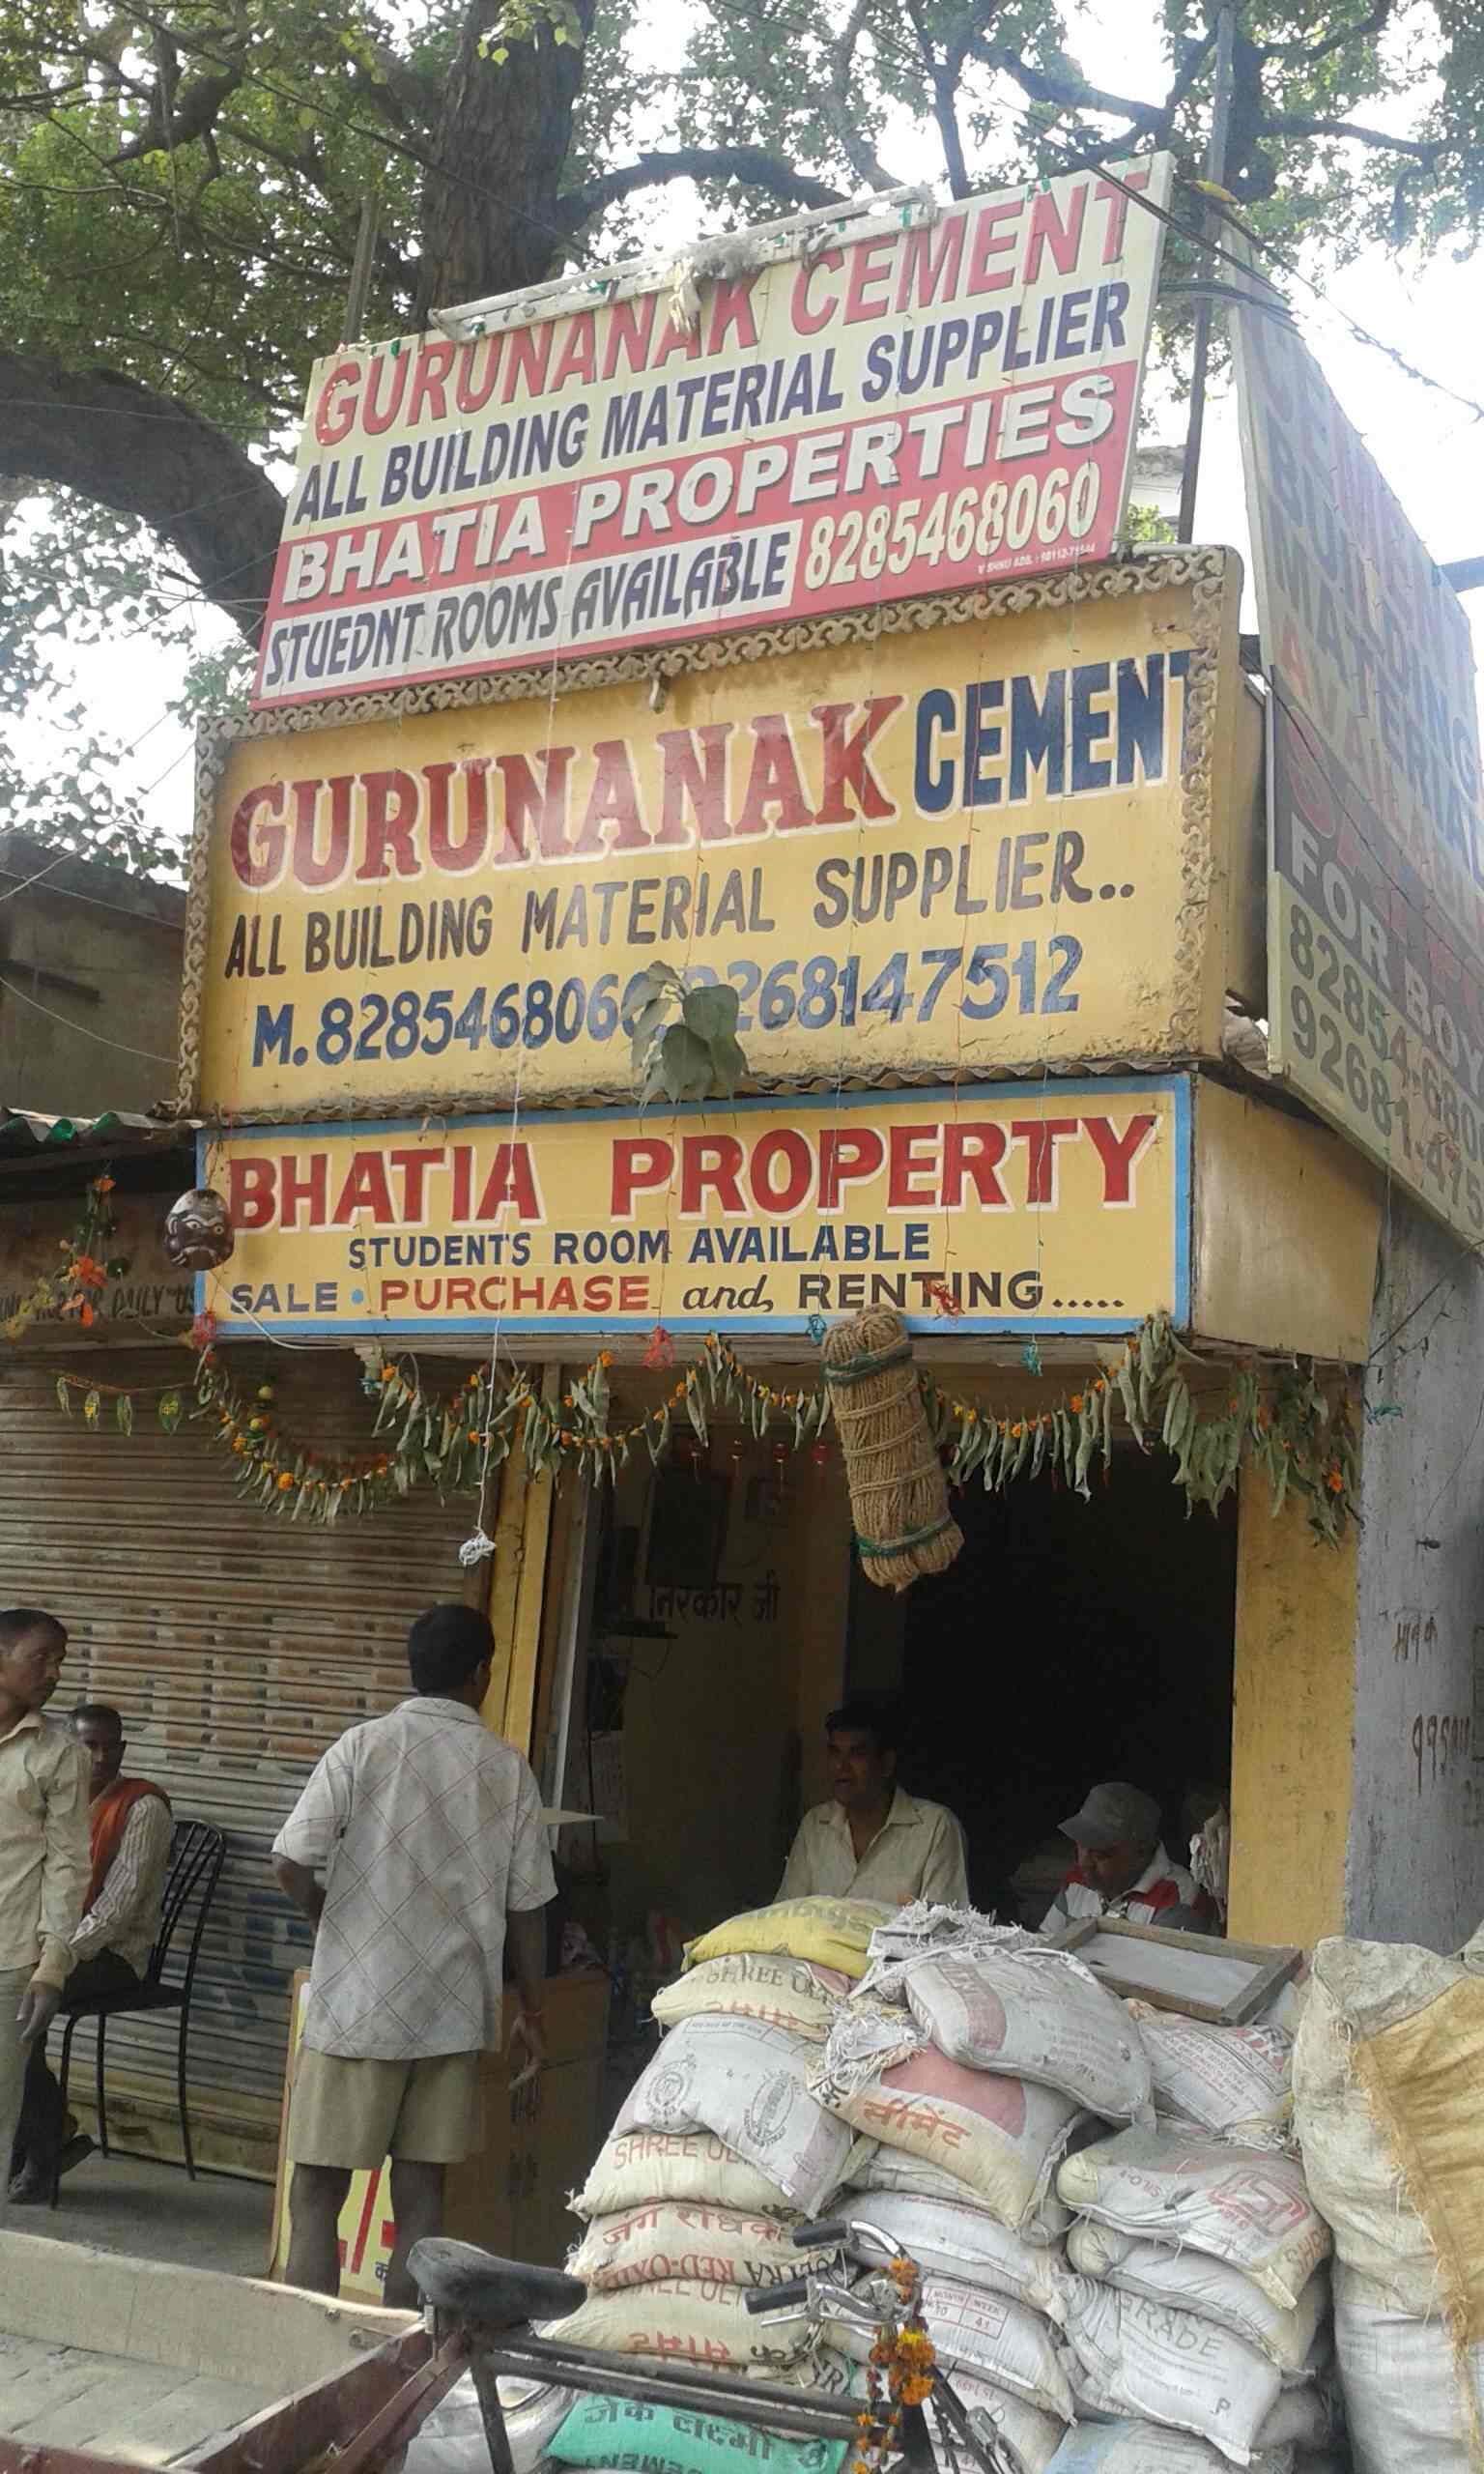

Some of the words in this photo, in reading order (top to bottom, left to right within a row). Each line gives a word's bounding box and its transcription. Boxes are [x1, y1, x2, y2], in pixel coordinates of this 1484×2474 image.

[314, 263, 766, 446] GURUNANAK
[790, 170, 1150, 336] CEMENT
[293, 455, 367, 526] ALL
[380, 402, 589, 507] BUILDING
[601, 348, 844, 461] MATERIAL
[862, 281, 1132, 402] SUPPLIER
[282, 496, 547, 605] BHATIA
[573, 375, 1117, 548] PROPERTIES
[803, 461, 1101, 591] 8285468060
[265, 602, 428, 686] STUEDNT
[432, 575, 565, 662] ROOMS
[571, 531, 791, 639] AVAILABLE
[230, 695, 904, 889] GURUNANAK
[225, 913, 286, 979] ALL
[304, 894, 493, 973] BUILDING
[521, 868, 775, 955] MATERIAL
[1290, 810, 1391, 993] FOR
[230, 1141, 541, 1229] BHATIA
[611, 1114, 1157, 1218] PROPERTY
[230, 1281, 338, 1313] SALE
[381, 1275, 650, 1314] PURCHASE
[349, 1231, 531, 1270] STUDENTS
[554, 1228, 669, 1265] ROOM
[688, 1223, 929, 1264] AVAILABLE
[614, 2134, 698, 2171] SHREE
